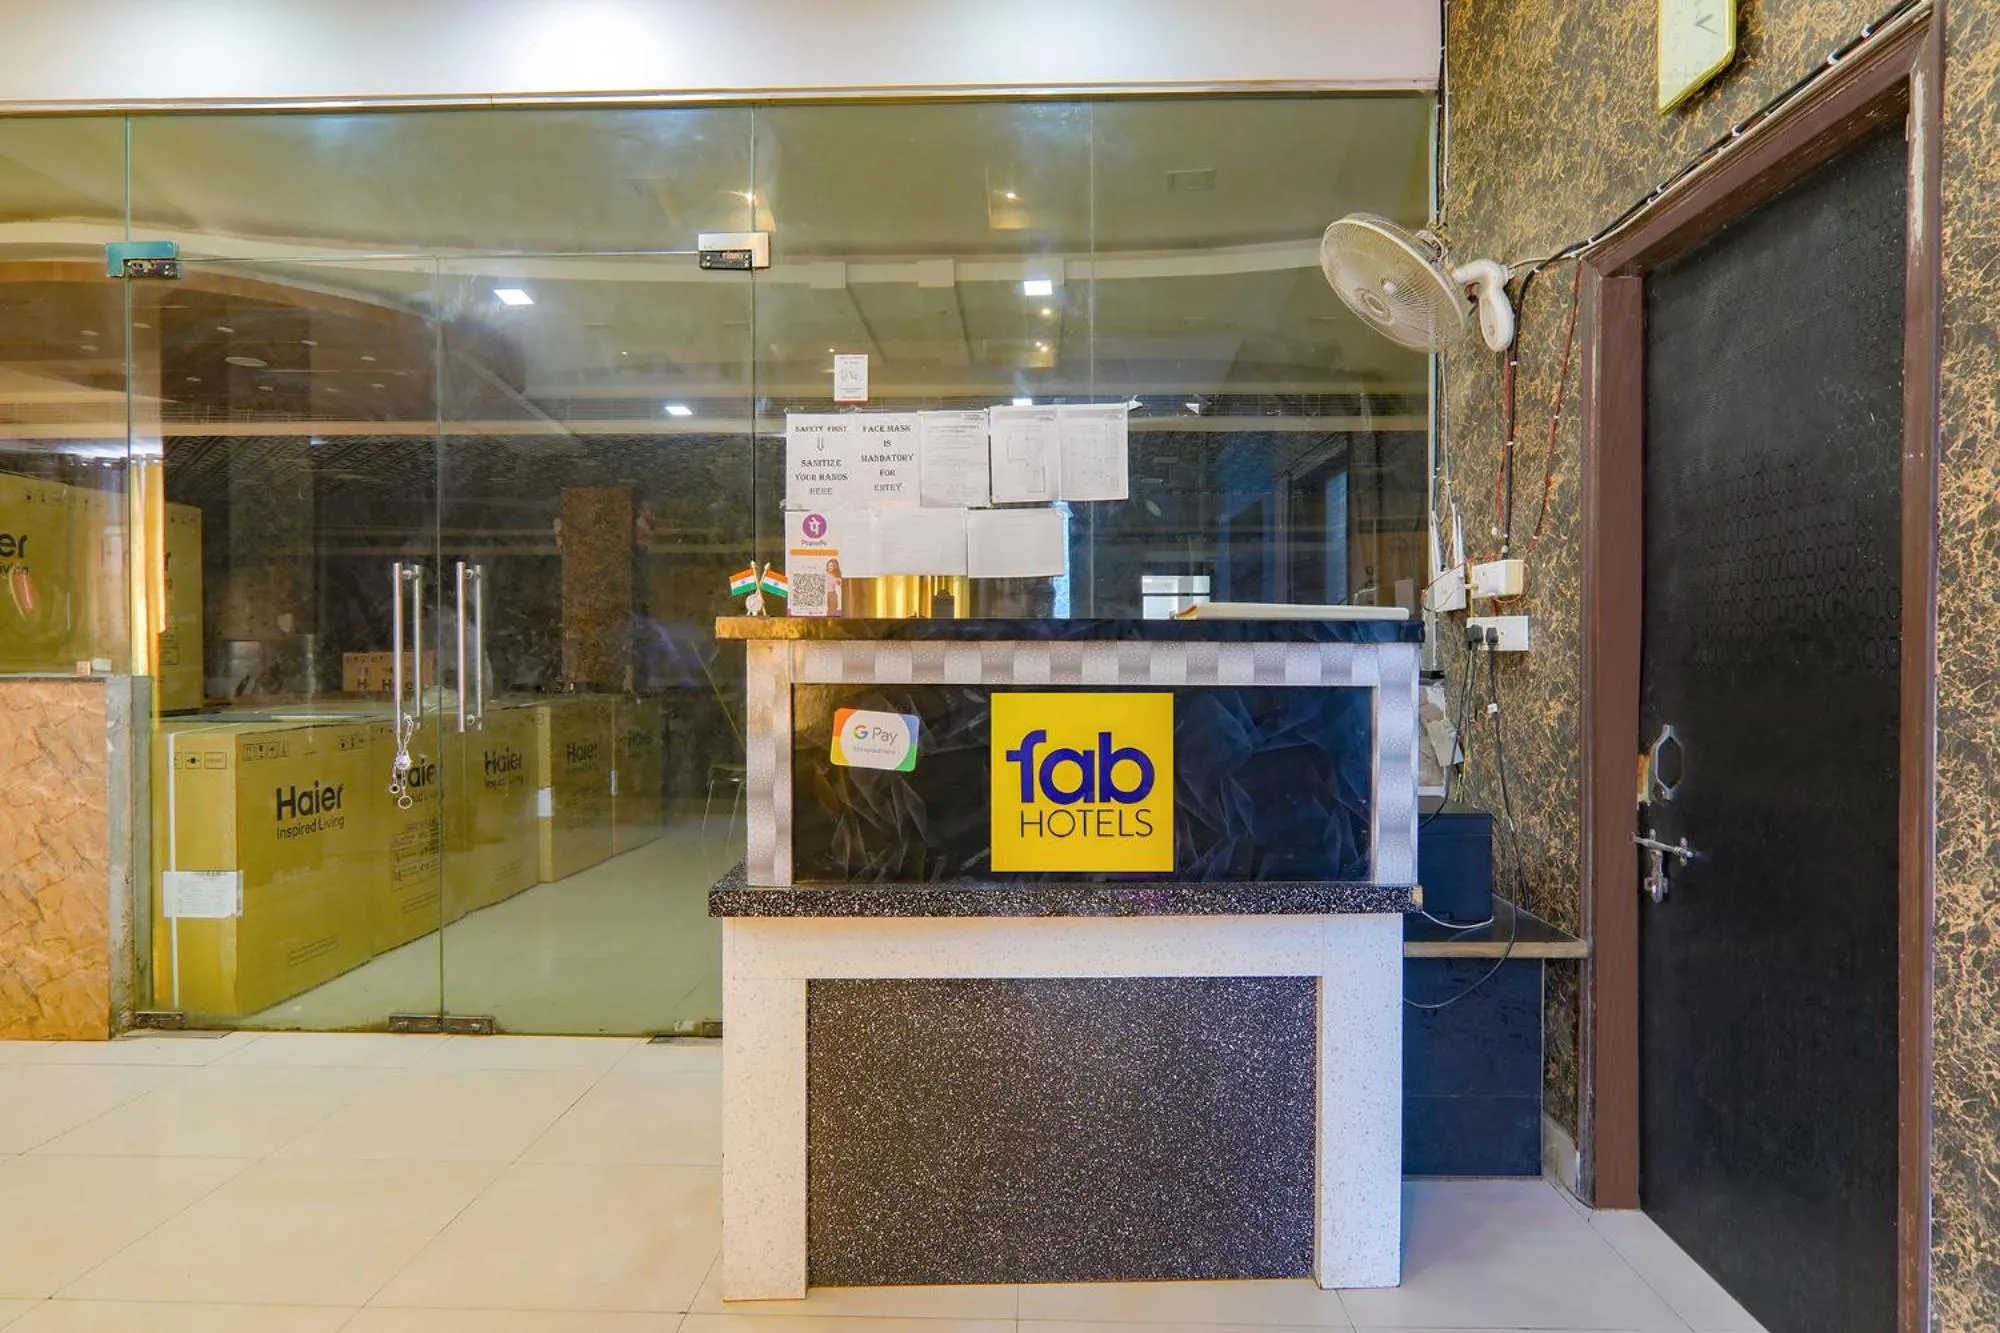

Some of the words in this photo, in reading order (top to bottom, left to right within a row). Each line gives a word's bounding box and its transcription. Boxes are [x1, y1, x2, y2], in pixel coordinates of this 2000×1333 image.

[795, 425, 823, 433] SAFETY
[827, 425, 848, 433] FIRST
[862, 424, 885, 433] FACE
[887, 424, 911, 433] MASK
[883, 439, 892, 448] IS
[861, 453, 914, 463] MANDATORY
[800, 459, 842, 468] SANITIZE
[794, 473, 817, 482] YOUR
[819, 473, 849, 481] HANDS
[879, 469, 896, 477] FOR
[809, 487, 833, 496] HERE
[874, 482, 902, 492] ENTRY
[871, 726, 898, 746] Pay
[485, 748, 523, 775] Haier
[1006, 729, 1155, 805] fab
[276, 779, 343, 821] Haier
[1020, 808, 1153, 838] HOTELS
[276, 818, 317, 841] Inspired
